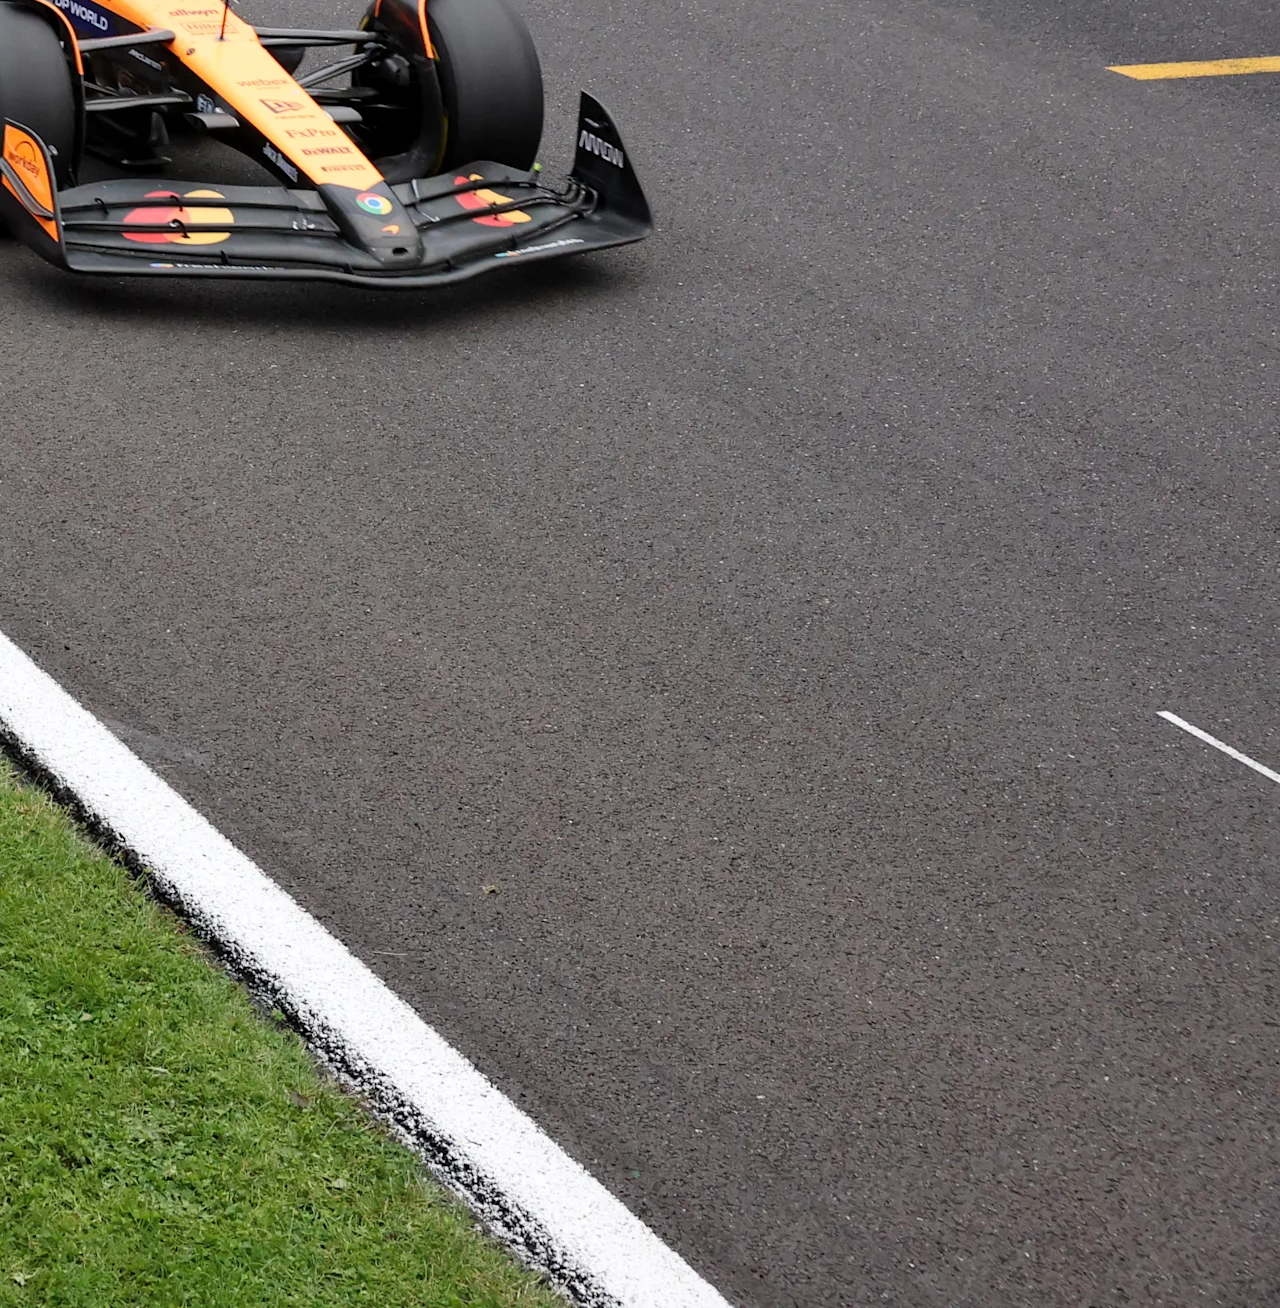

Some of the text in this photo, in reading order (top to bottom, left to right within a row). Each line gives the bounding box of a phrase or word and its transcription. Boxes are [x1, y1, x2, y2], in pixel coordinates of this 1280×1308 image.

[69, 0, 108, 32] WORLD
[168, 9, 220, 18] allwyn
[236, 78, 289, 87] webex
[285, 129, 337, 139] FxPro
